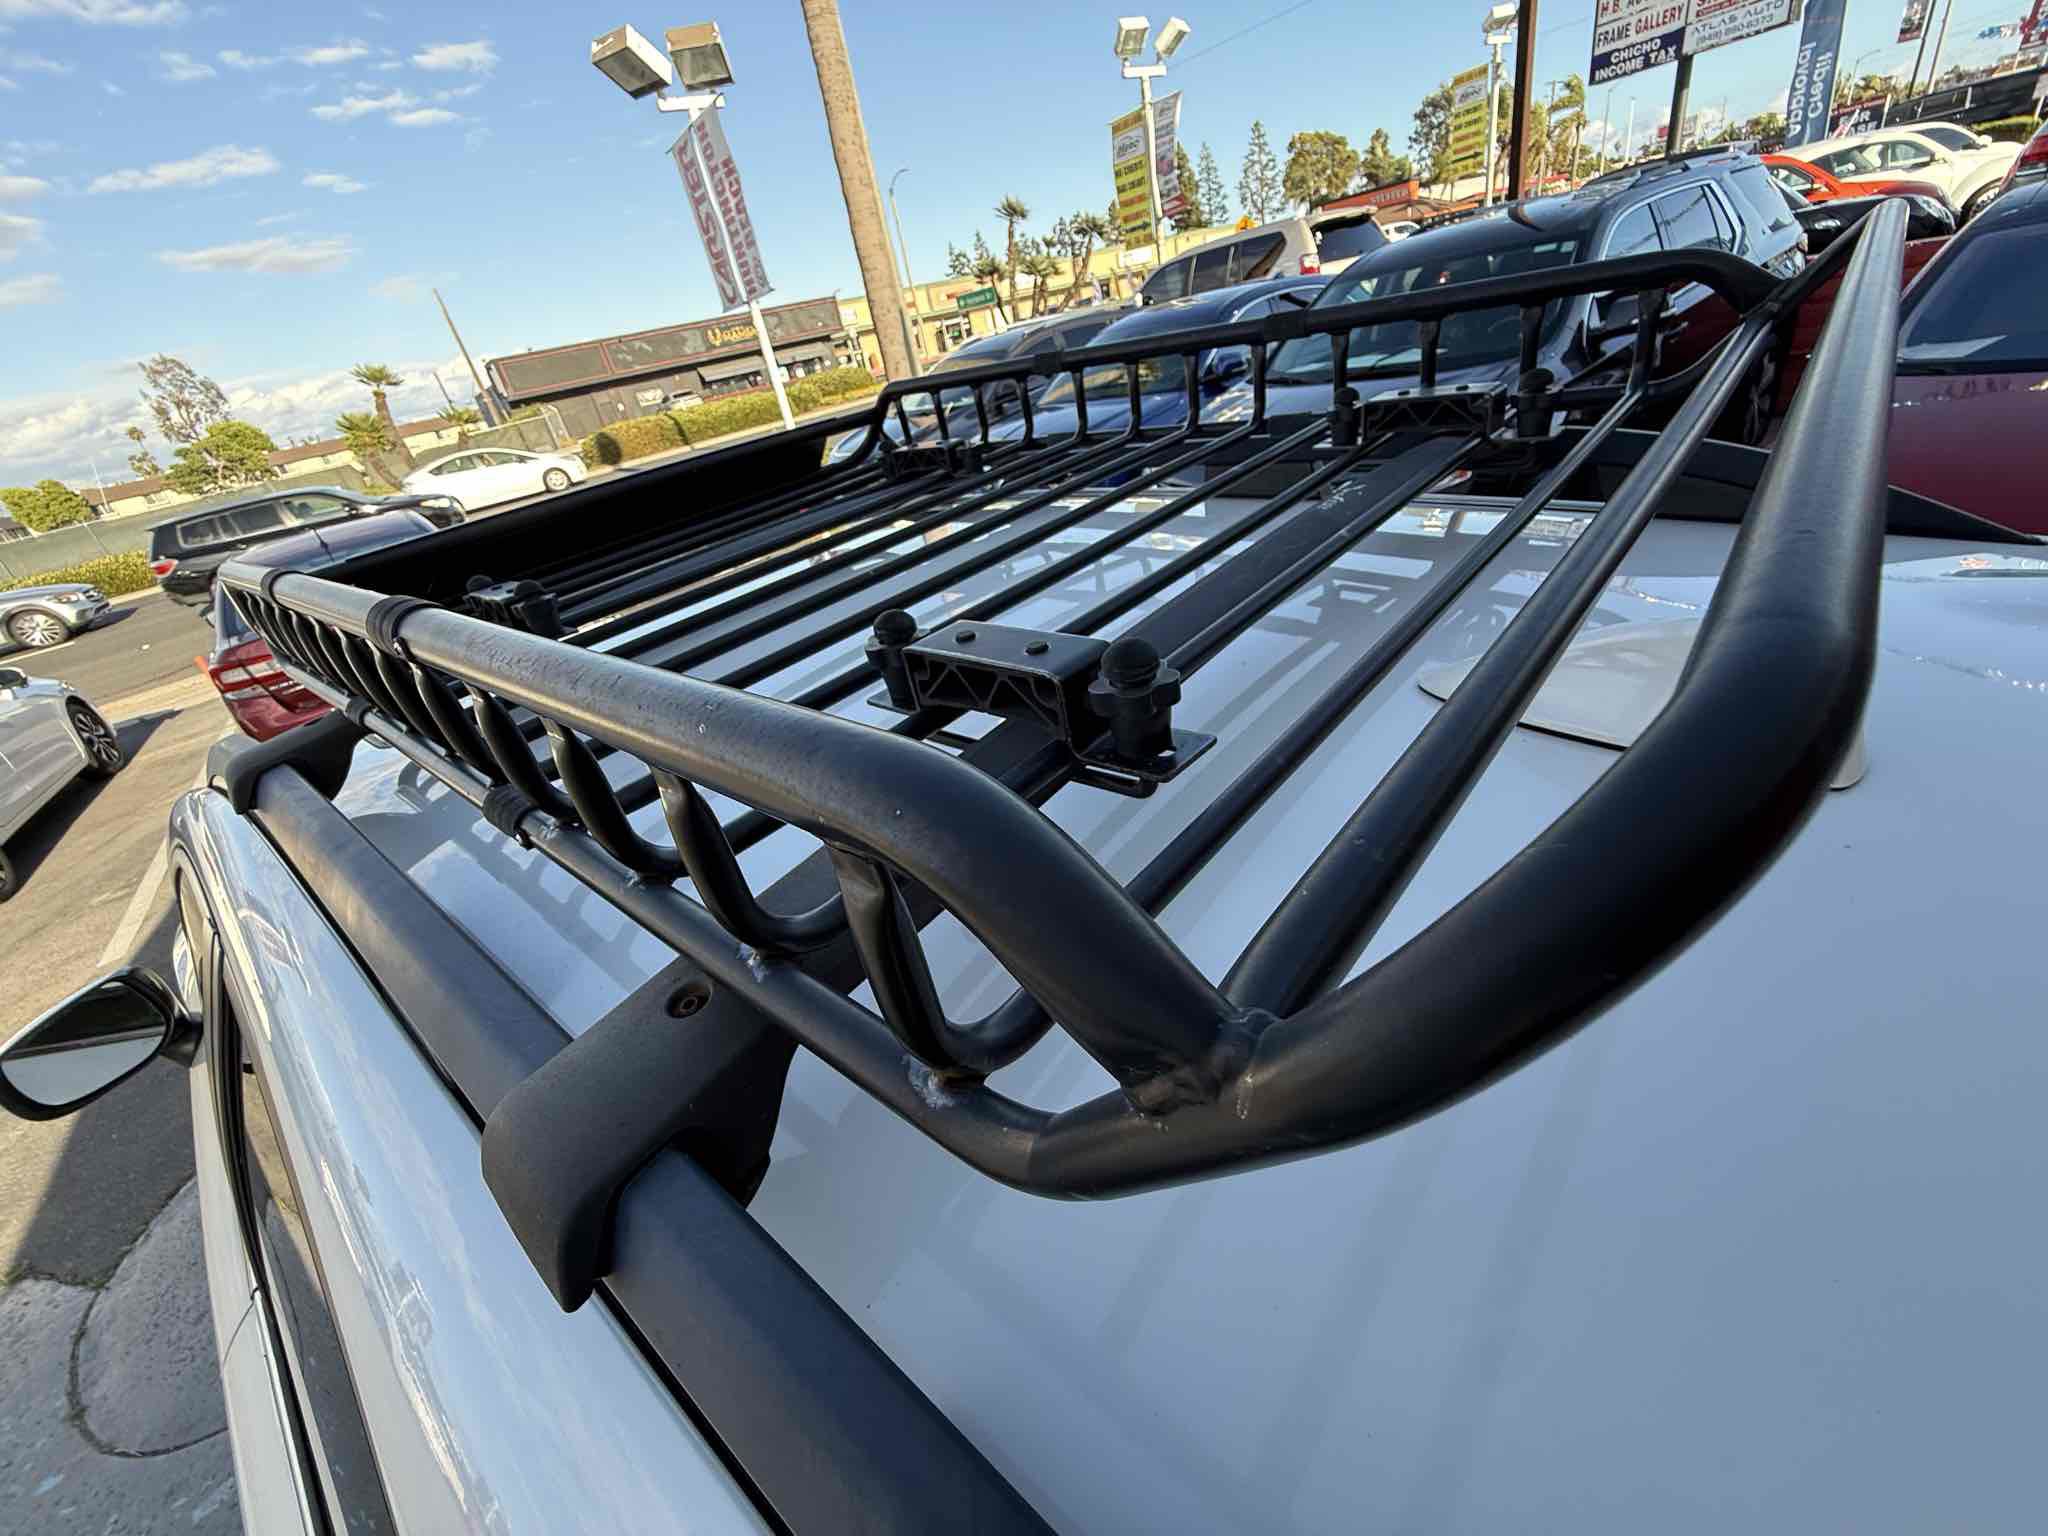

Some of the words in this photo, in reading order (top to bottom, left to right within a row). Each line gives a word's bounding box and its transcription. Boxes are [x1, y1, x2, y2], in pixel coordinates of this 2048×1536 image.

[1743, 0, 1784, 18] AUTO
[1597, 22, 1632, 48] FRAME
[1635, 3, 1684, 34] GALLERY
[1595, 56, 1645, 80] INCOME
[1649, 45, 1677, 64] TAX
[1610, 38, 1661, 63] CHICHO
